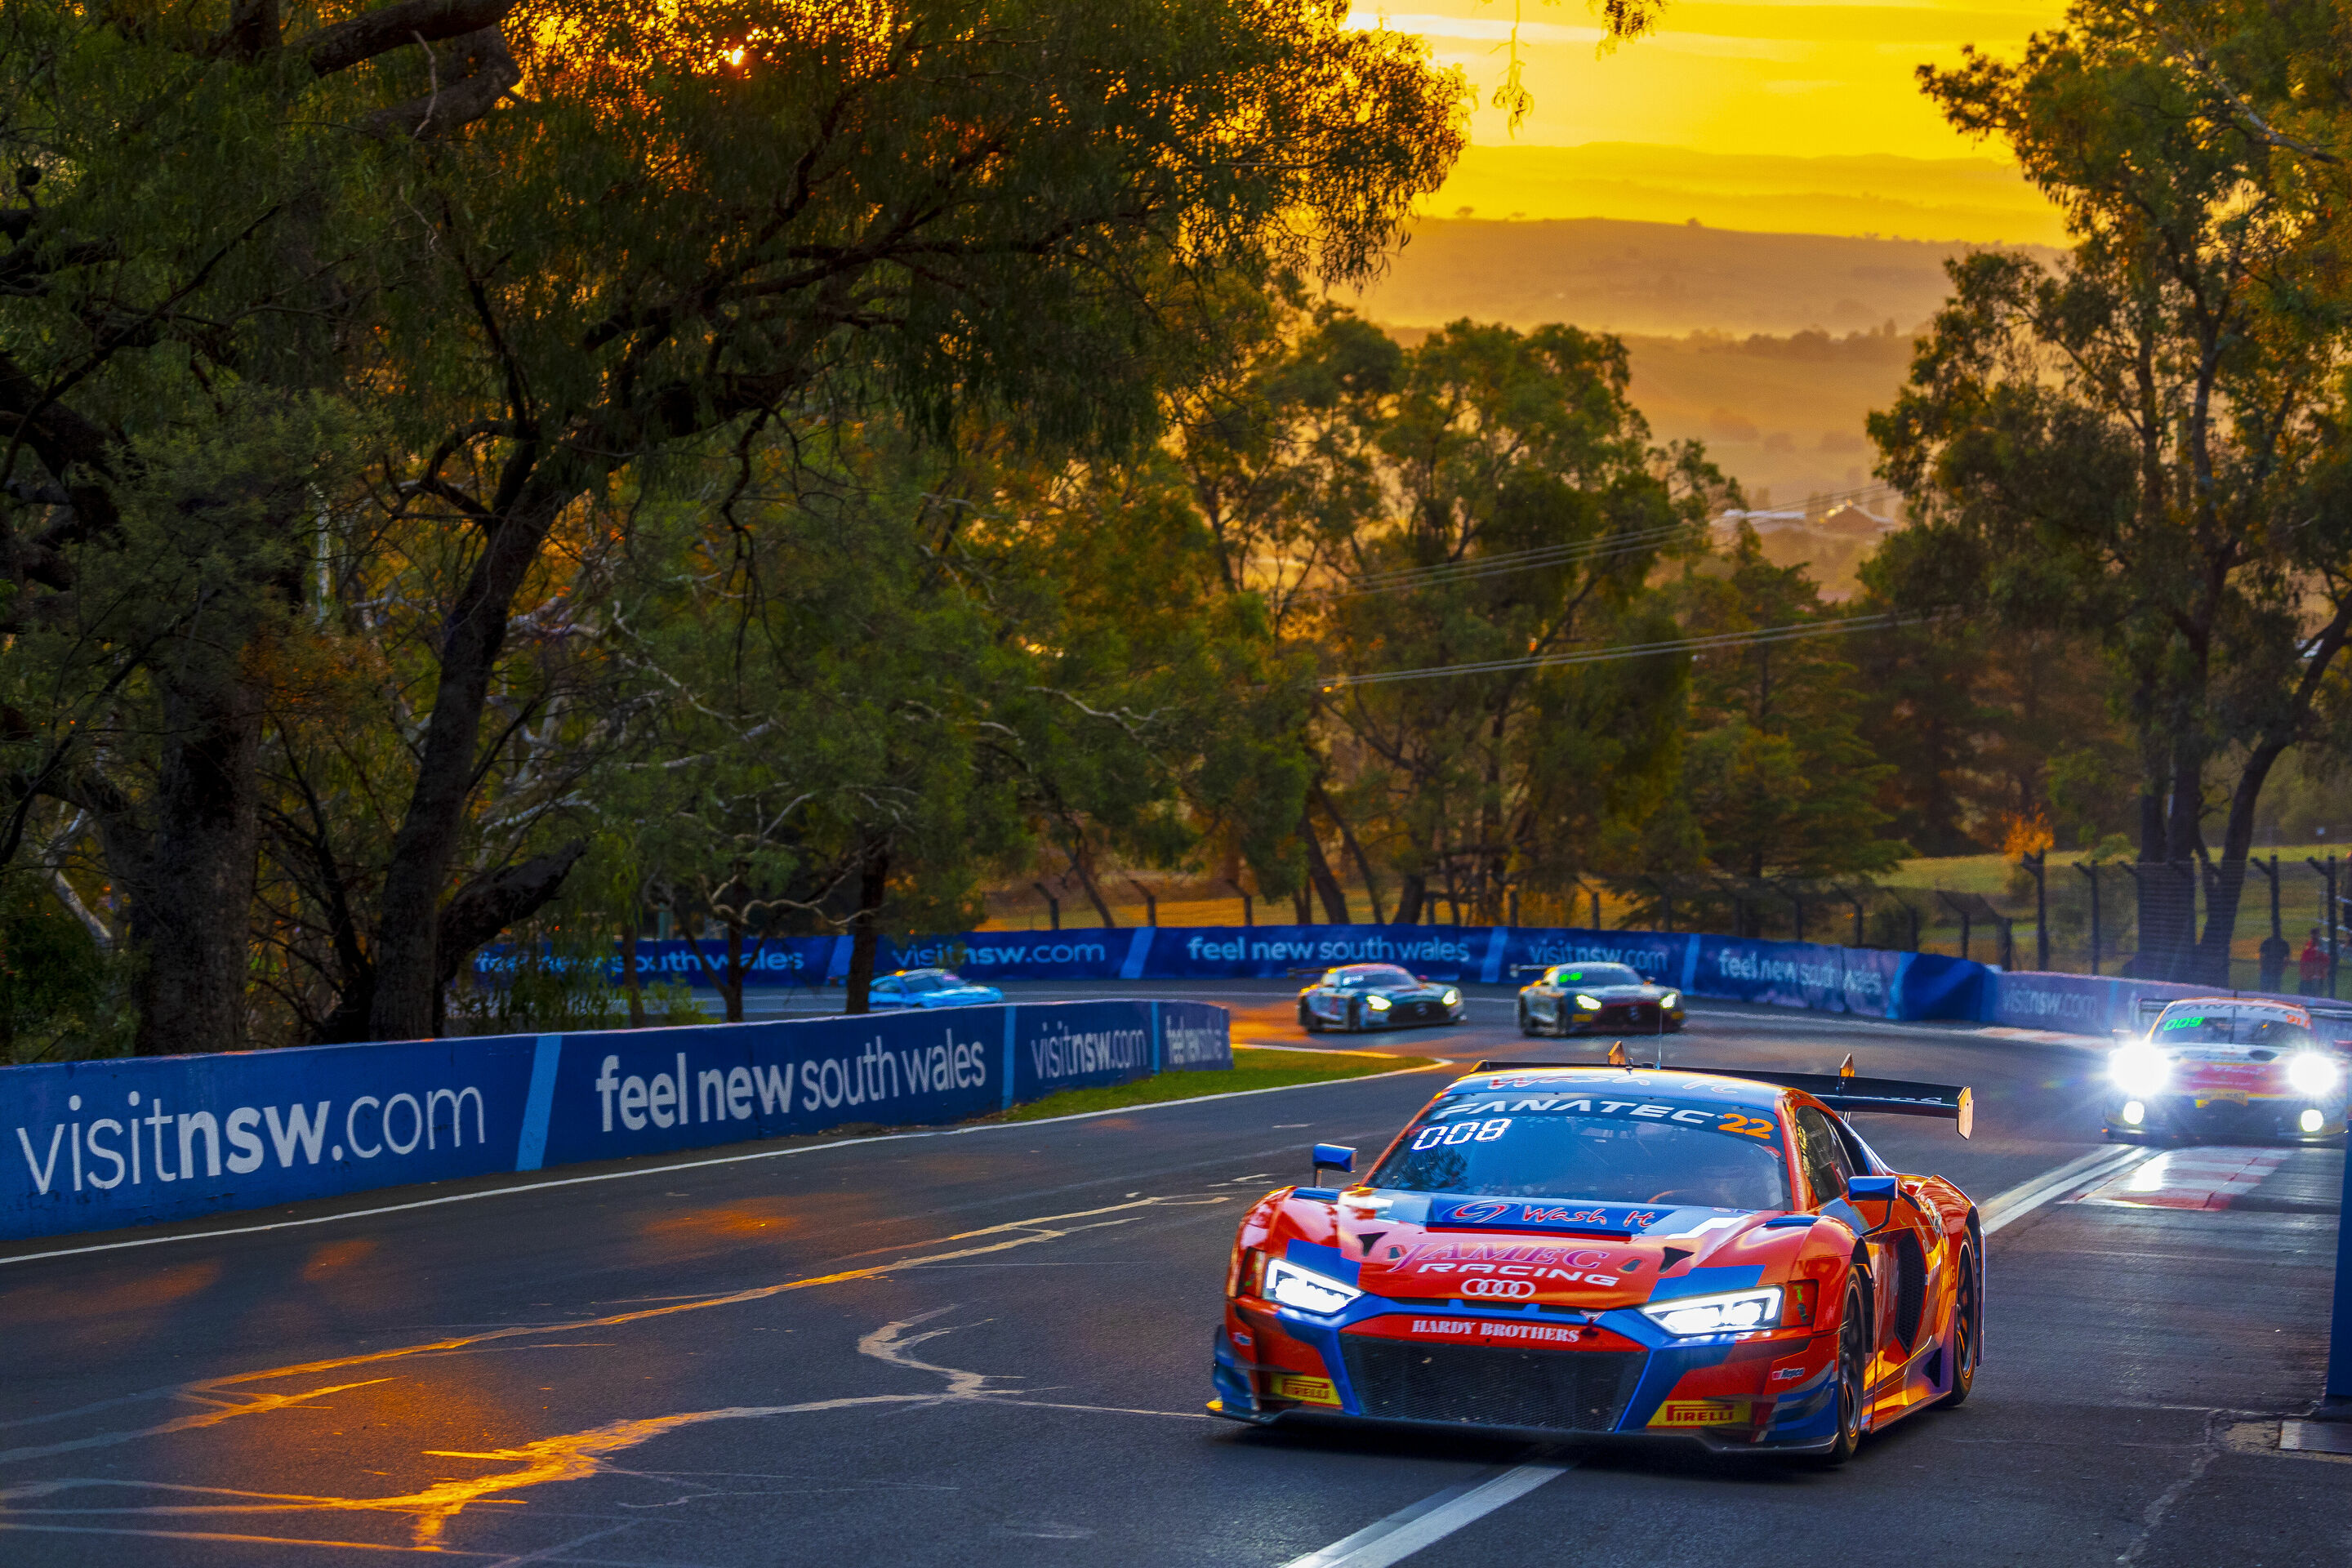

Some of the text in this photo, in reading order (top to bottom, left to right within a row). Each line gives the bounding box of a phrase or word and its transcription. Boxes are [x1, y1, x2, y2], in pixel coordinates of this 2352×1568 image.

[892, 943, 1106, 967] visitnsw.com
[1187, 935, 1469, 962] feel new south wales
[1718, 948, 1757, 981] feel
[2163, 1016, 2205, 1031] 009
[1031, 1021, 1147, 1080] visitnsw.com
[595, 1028, 987, 1133] feel new south wales
[1486, 1074, 1650, 1090] Wash
[1433, 1099, 1775, 1139] FANATEC 22
[16, 1086, 485, 1196] visitnsw.com
[1412, 1117, 1512, 1152] 008
[1521, 1205, 1656, 1228] Wash It
[1387, 1241, 1611, 1273] JAMEC
[1416, 1262, 1620, 1288] RACING
[1410, 1319, 1580, 1343] HARDY BROTHERS
[1667, 1404, 1735, 1423] PIRELLI
